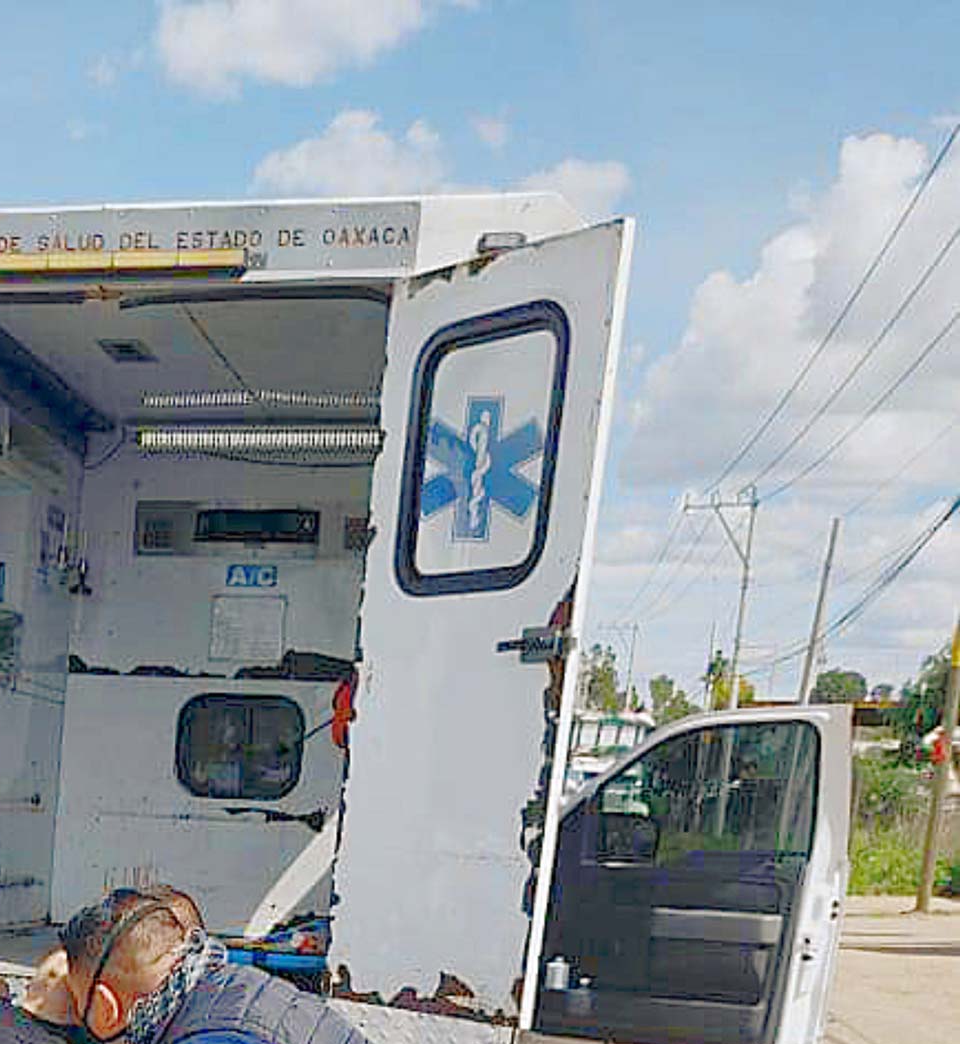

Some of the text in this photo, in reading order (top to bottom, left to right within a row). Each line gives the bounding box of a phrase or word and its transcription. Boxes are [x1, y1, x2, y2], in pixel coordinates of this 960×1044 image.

[38, 232, 104, 251] SALUD
[119, 231, 159, 250] DEL
[176, 230, 263, 250] ESTADO
[279, 229, 306, 248] DE
[322, 227, 411, 248] OAXACA
[229, 565, 276, 586] A/C
